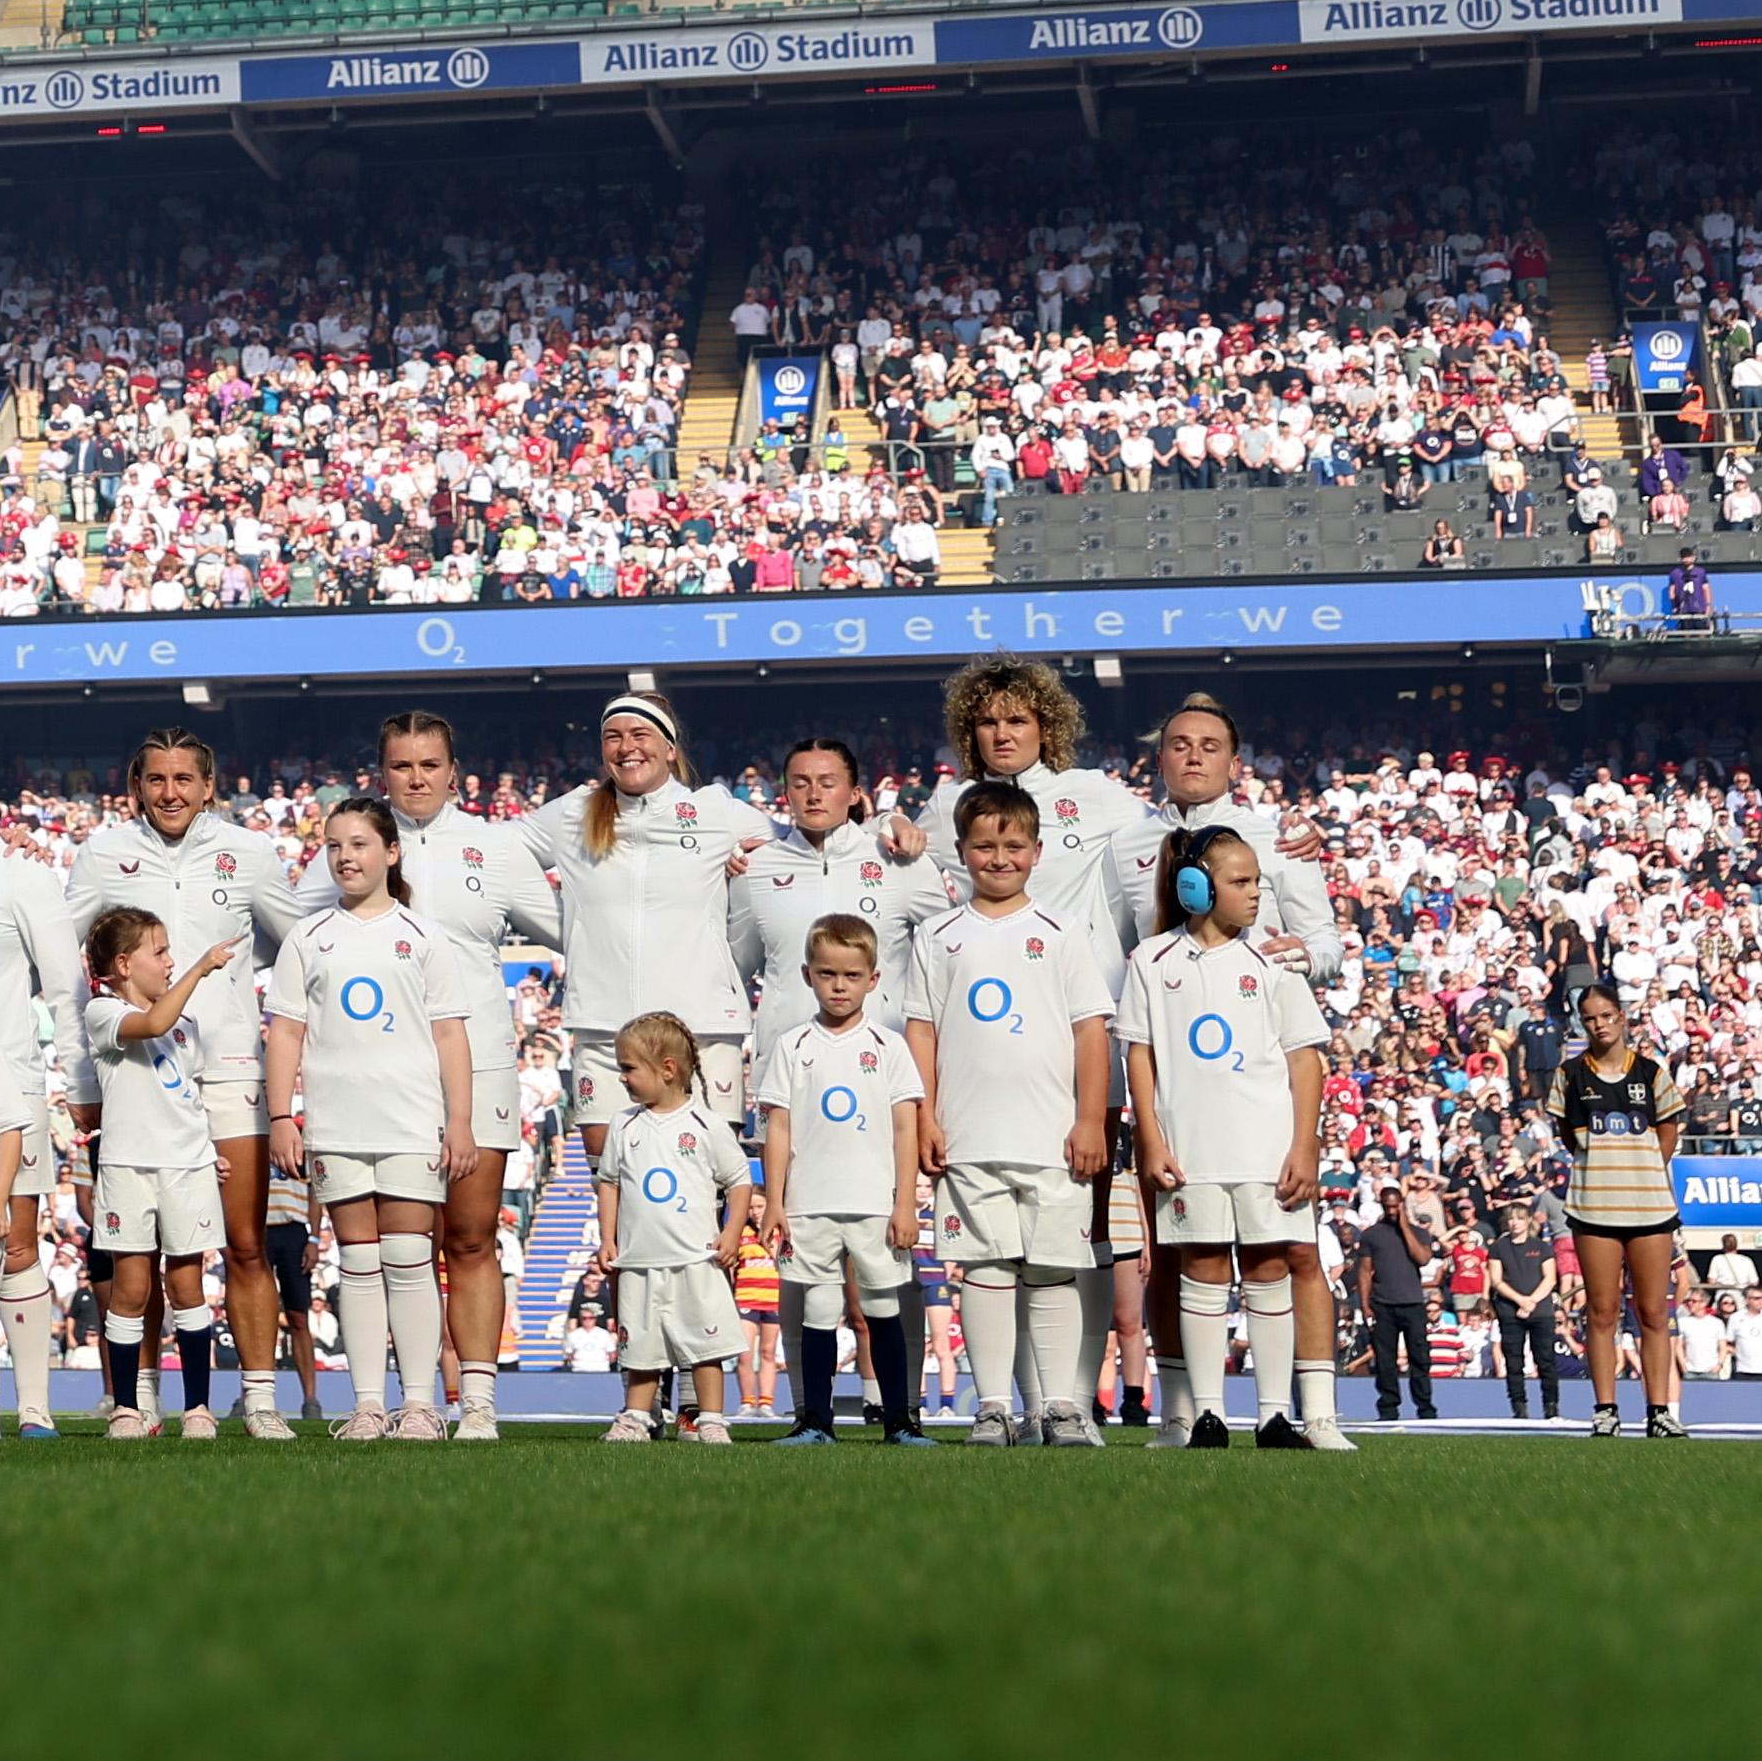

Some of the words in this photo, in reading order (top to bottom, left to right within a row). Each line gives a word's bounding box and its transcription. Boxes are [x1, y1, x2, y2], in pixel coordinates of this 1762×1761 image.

[1324, 0, 1448, 32] Allianz
[1029, 18, 1151, 49] Allianz
[603, 42, 719, 73] Allianz
[777, 30, 915, 62] Stadium
[91, 70, 221, 101] Stadium
[327, 57, 440, 88] Allianz
[1649, 360, 1688, 372] Allianz
[774, 395, 809, 407] Allianz
[703, 602, 1183, 655] Together
[1238, 603, 1343, 633] we
[83, 640, 177, 666] we
[1592, 1112, 1640, 1130] hmt
